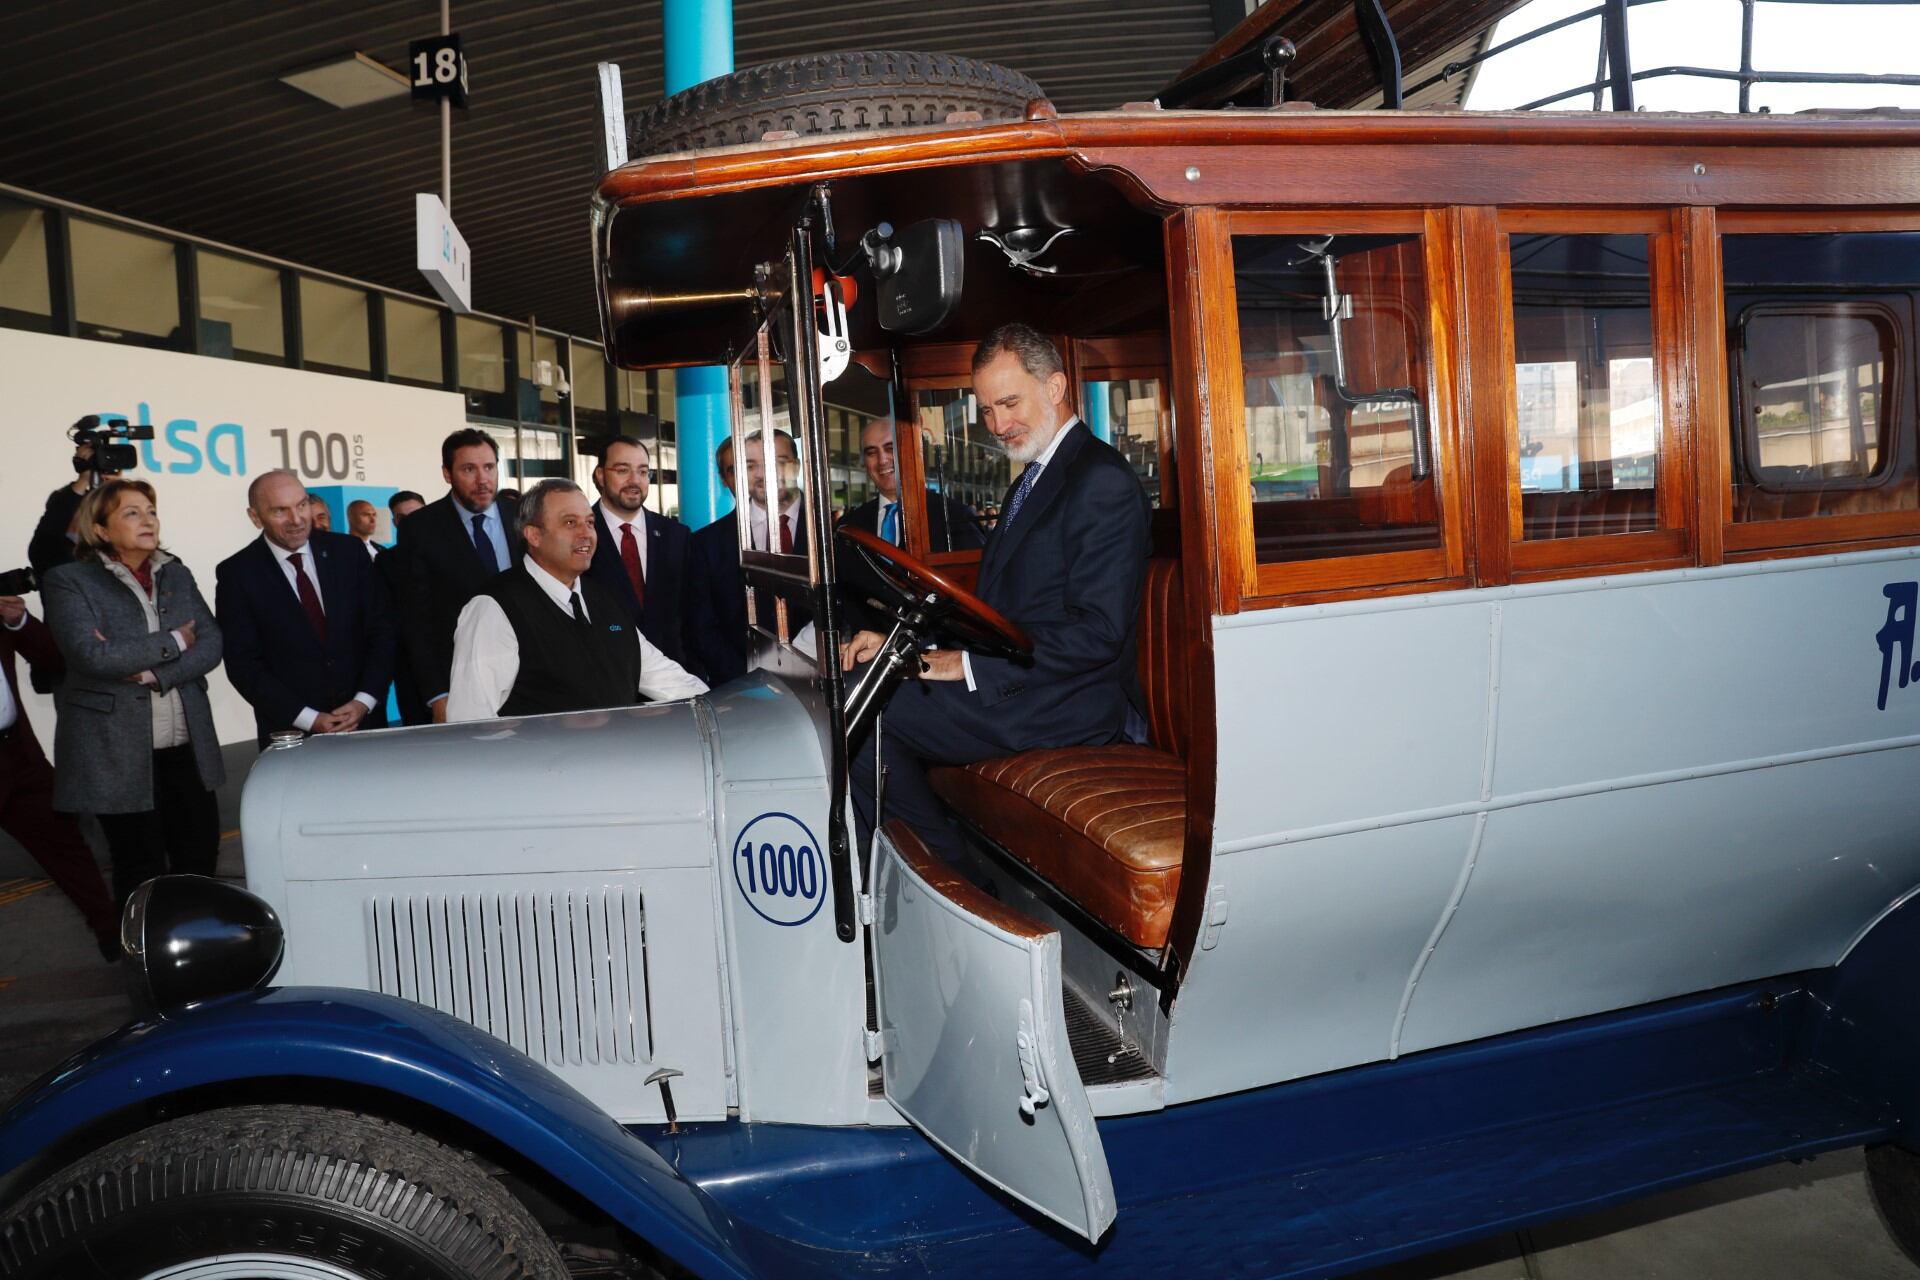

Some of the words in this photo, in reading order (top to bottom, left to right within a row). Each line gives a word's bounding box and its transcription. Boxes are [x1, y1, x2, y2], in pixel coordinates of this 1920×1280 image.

[414, 47, 457, 87] 18
[271, 428, 349, 480] 100
[353, 434, 366, 482] años
[741, 841, 817, 899] 1000
